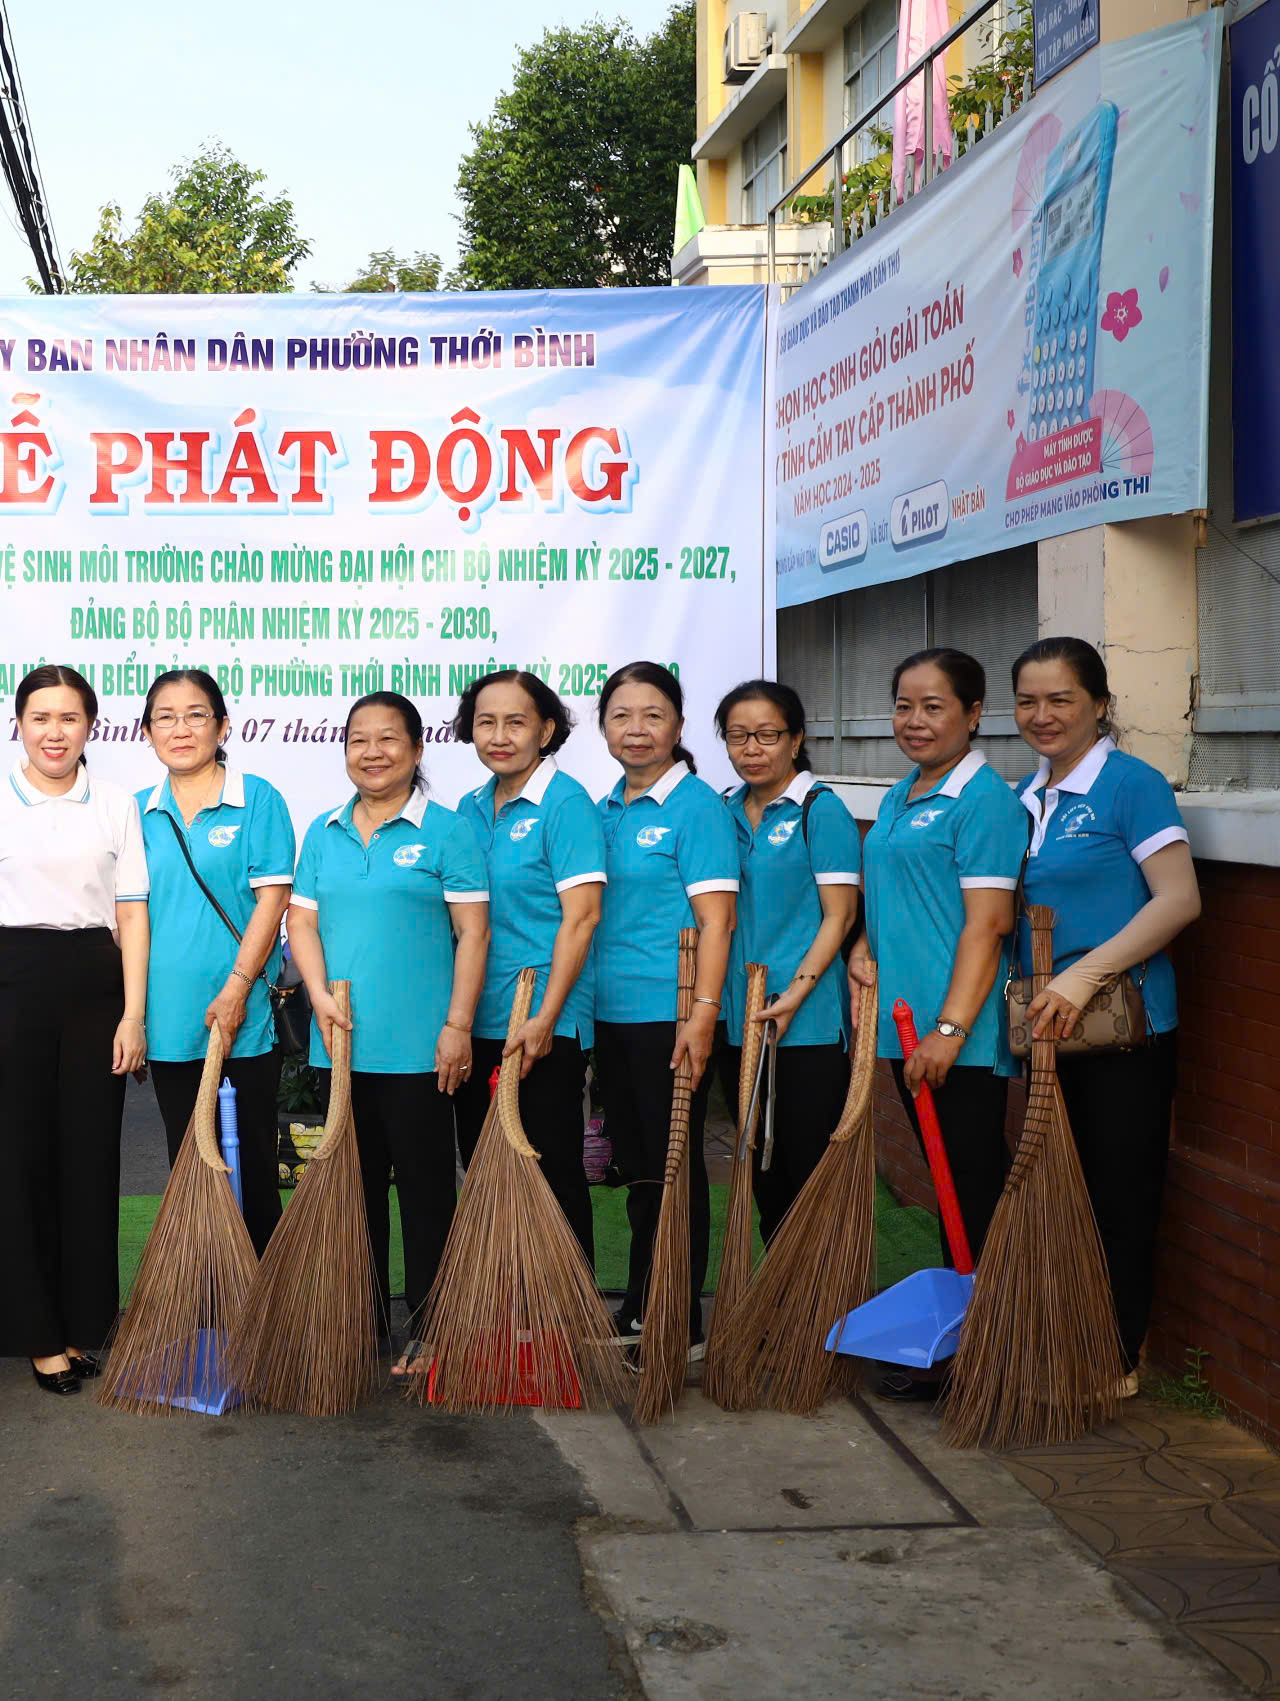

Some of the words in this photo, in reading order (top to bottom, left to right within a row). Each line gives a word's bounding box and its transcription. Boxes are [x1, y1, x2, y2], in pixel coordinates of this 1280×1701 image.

[26, 337, 93, 372] BAN
[105, 331, 196, 371] NHÂN
[206, 331, 274, 371] DÂN
[286, 329, 419, 371] PHƯỜNG
[429, 328, 502, 370] THỚI
[514, 326, 596, 368] BÌNH
[775, 386, 800, 435] HỌN
[803, 371, 827, 421] HỌC
[829, 352, 856, 400] SINH
[859, 326, 887, 382] GIỎI
[890, 305, 918, 364] GIẢI
[922, 280, 964, 345] TOÁN
[782, 440, 806, 483] TÍNH
[807, 422, 833, 470] CẦM
[835, 415, 856, 457] TAY
[858, 391, 885, 446] CẤP
[887, 376, 936, 432] THÀNH
[941, 336, 976, 407] PHỐ
[88, 407, 341, 507] PHÁT
[368, 405, 631, 523] ĐỘNG
[1043, 439, 1057, 459] MÁY
[1057, 435, 1073, 453] TÍNH
[1073, 427, 1094, 449] ĐƯỢC
[813, 479, 832, 514] HỌC
[833, 471, 853, 501] 2024
[860, 457, 881, 490] 2025
[1015, 471, 1024, 493] BỘ
[1024, 468, 1040, 487] GIÁO
[1040, 465, 1053, 484] DỤC
[1053, 459, 1063, 477] VÀ
[1063, 454, 1078, 474] ĐÀO
[1078, 451, 1092, 472] TẠO
[911, 502, 939, 534] PILOT
[951, 489, 970, 523] NHẬT
[971, 483, 986, 513] BẢN
[1005, 510, 1020, 529] CHO
[1020, 501, 1039, 524] PHÉP
[1040, 497, 1063, 518] MANG
[1063, 488, 1081, 511] VÀO
[1081, 480, 1120, 507] PHÒNG
[1123, 475, 1150, 497] THI
[826, 521, 860, 558] CASIO
[22, 549, 72, 583] SINH
[79, 543, 119, 583] MÔI
[124, 542, 204, 584] TRƯỜNG
[210, 542, 264, 584] CHÀO
[270, 542, 333, 584] MỪNG
[339, 549, 373, 591] ĐẠI
[380, 542, 415, 591] HỘI
[421, 549, 457, 584] CHI
[463, 542, 491, 590] BỘ
[497, 541, 569, 590] NHIỆM
[575, 540, 602, 582] KỲ
[608, 547, 659, 581] 2025
[664, 561, 673, 570] -
[679, 545, 736, 584] 2027,
[70, 596, 126, 640] ĐẢNG
[132, 599, 160, 647] BỘ
[165, 599, 193, 647] BỘ
[199, 599, 255, 647] PHẬN
[261, 599, 331, 647] NHIỆM
[337, 599, 364, 640] KỲ
[369, 606, 420, 640] 2025
[425, 621, 434, 629] -
[439, 606, 498, 644] 2030,
[102, 650, 148, 697] BIỂU
[216, 656, 244, 704] BỘ
[250, 656, 333, 697] PHƯỜNG
[341, 656, 385, 697] THỚI
[391, 656, 441, 697] BÌNH
[558, 663, 609, 697] 2025
[240, 718, 277, 743] 07
[282, 717, 347, 743] thán
